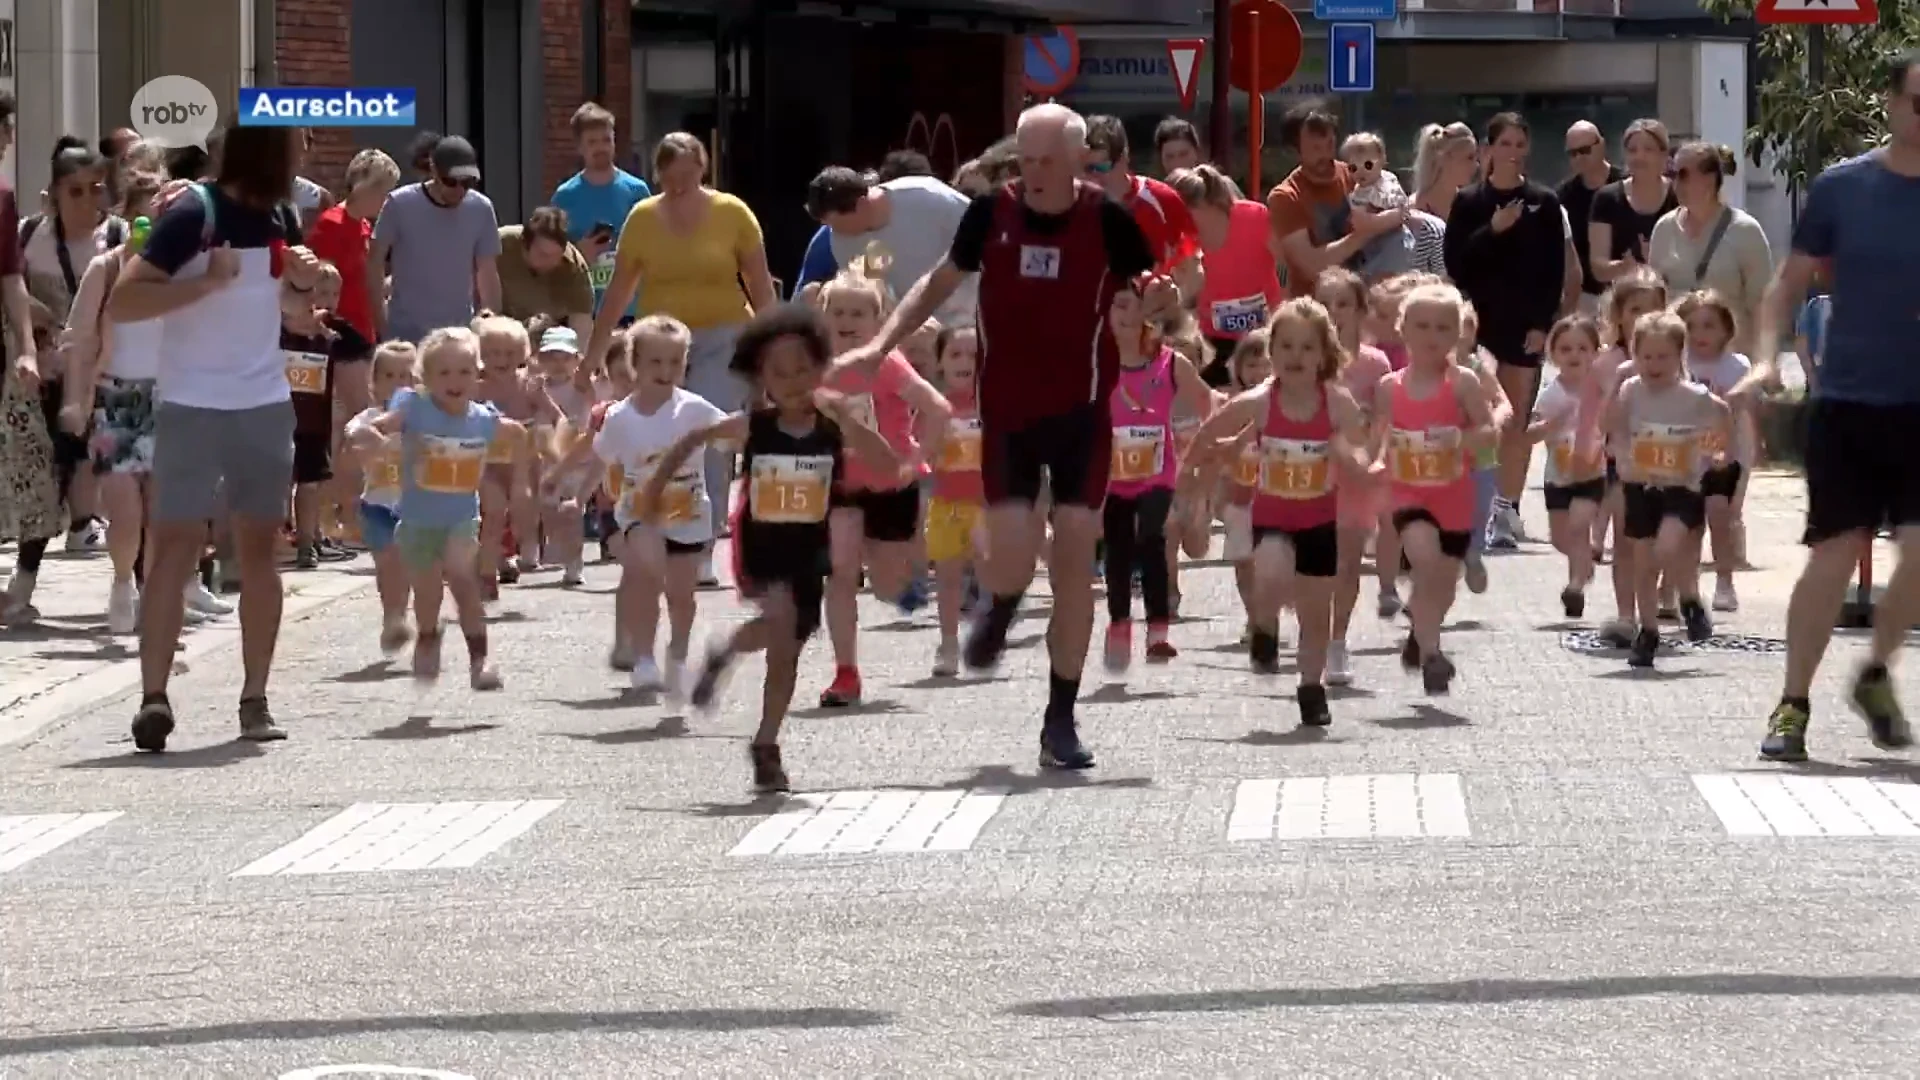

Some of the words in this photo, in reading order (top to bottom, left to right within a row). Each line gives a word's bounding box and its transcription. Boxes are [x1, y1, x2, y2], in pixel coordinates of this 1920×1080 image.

[1226, 312, 1257, 331] 509
[290, 369, 309, 385] 92
[1411, 454, 1438, 476] 12
[1653, 447, 1676, 467] 18
[1284, 466, 1313, 488] 13
[776, 485, 808, 510] 15
